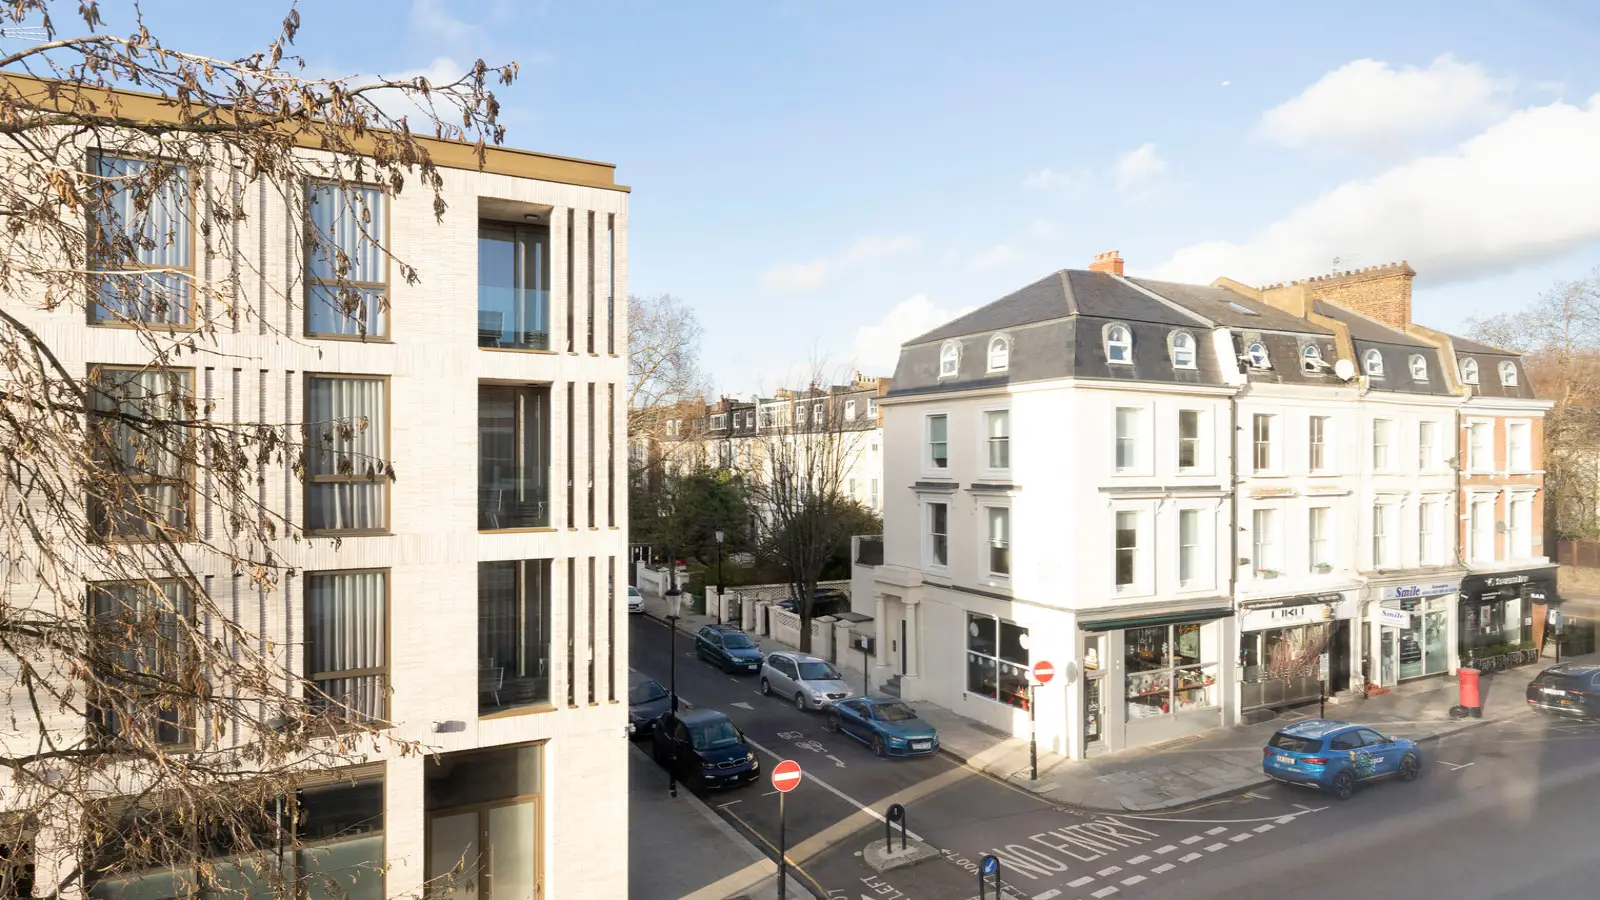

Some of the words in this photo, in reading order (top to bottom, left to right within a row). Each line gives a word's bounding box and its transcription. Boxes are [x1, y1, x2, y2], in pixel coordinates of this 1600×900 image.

[1395, 585, 1421, 598] Smile
[1381, 610, 1405, 619] Smile
[978, 844, 1069, 880] NO
[1028, 816, 1160, 862] ENTRY
